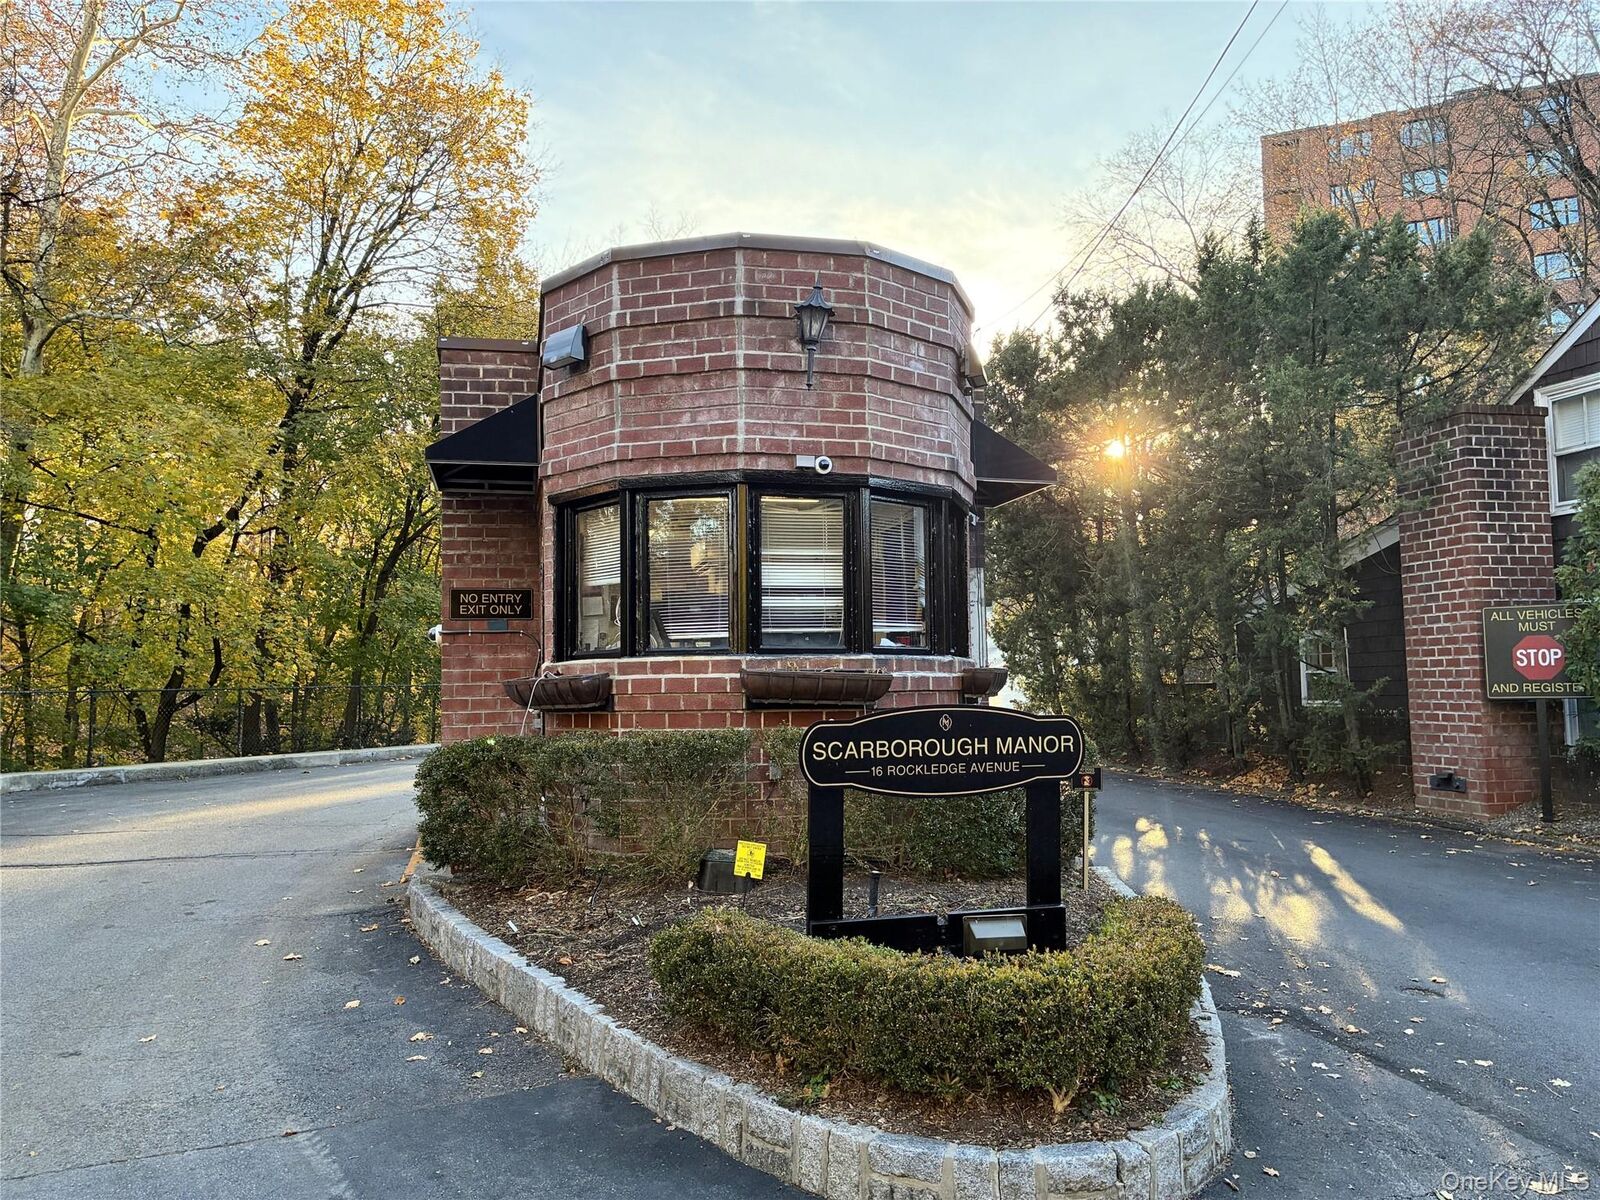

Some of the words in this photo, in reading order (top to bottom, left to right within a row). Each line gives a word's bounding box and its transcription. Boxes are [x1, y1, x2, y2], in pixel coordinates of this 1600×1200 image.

[460, 593, 478, 604] NO
[481, 593, 522, 604] ENTRY
[459, 605, 487, 615] EXIT
[490, 605, 522, 615] ONLY
[1490, 611, 1514, 621] ALL
[1518, 621, 1556, 632] MUST
[1516, 648, 1562, 667] STOP
[1491, 683, 1519, 693] AND
[812, 737, 988, 761] SCARBOROUGH
[996, 735, 1075, 755] MANOR
[871, 766, 883, 777] 16
[887, 763, 966, 776] ROCKLEDGE
[970, 761, 1020, 773] AVENUE
